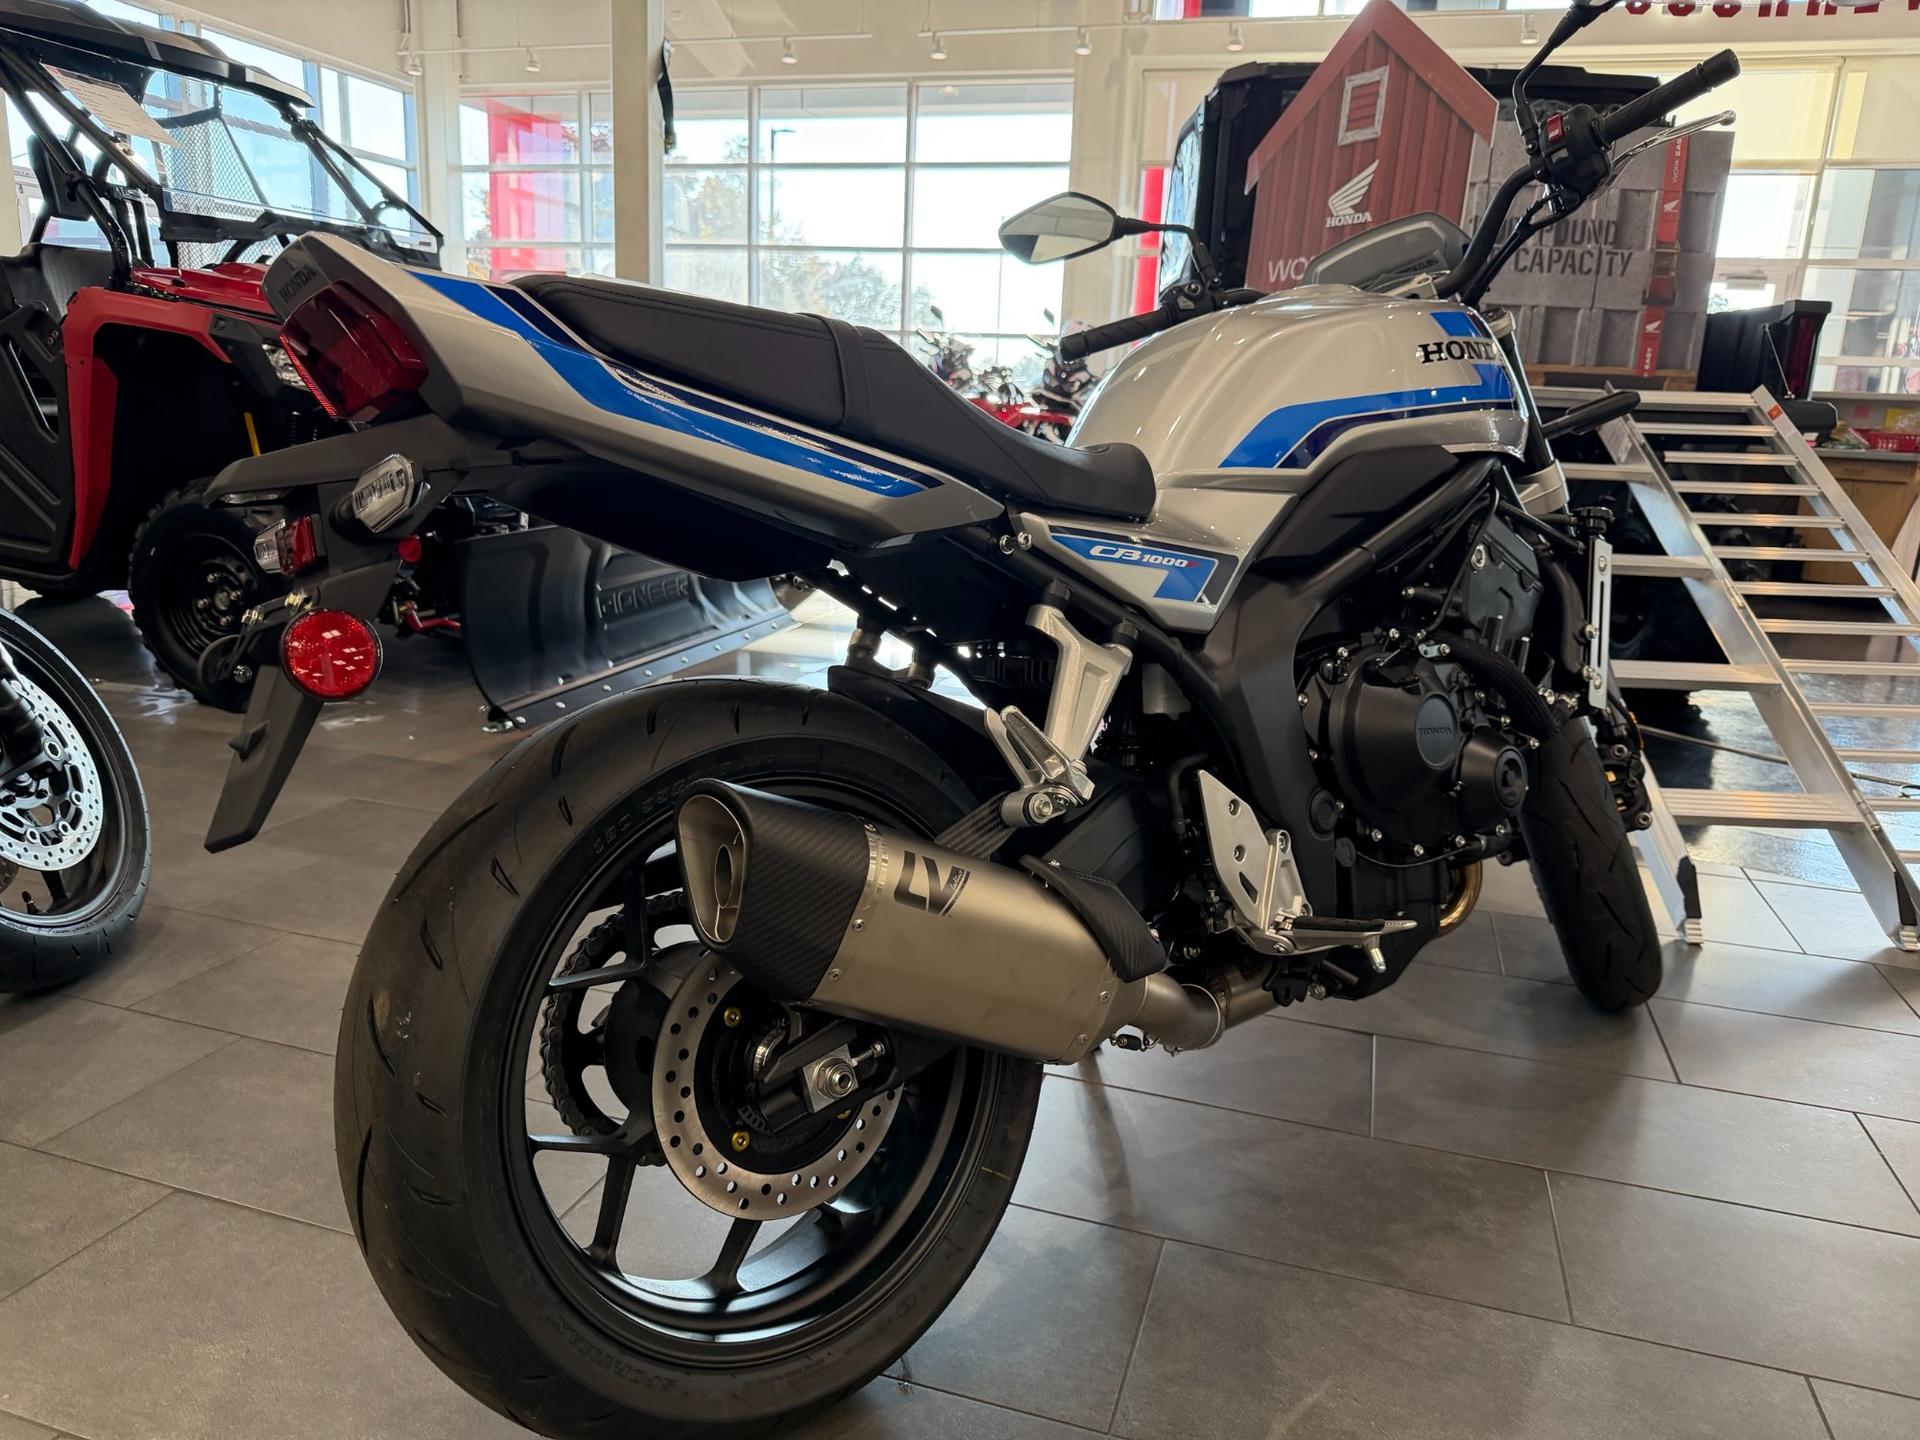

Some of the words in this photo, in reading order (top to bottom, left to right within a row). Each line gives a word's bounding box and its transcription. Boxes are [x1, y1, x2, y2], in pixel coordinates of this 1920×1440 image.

[1325, 211, 1373, 228] HONDA
[1268, 255, 1316, 283] WO
[1514, 248, 1633, 278] CAPACITY
[279, 266, 316, 303] HONDA
[595, 576, 690, 620] PIONEER
[1417, 726, 1453, 737] HONDA
[893, 849, 971, 917] LV
